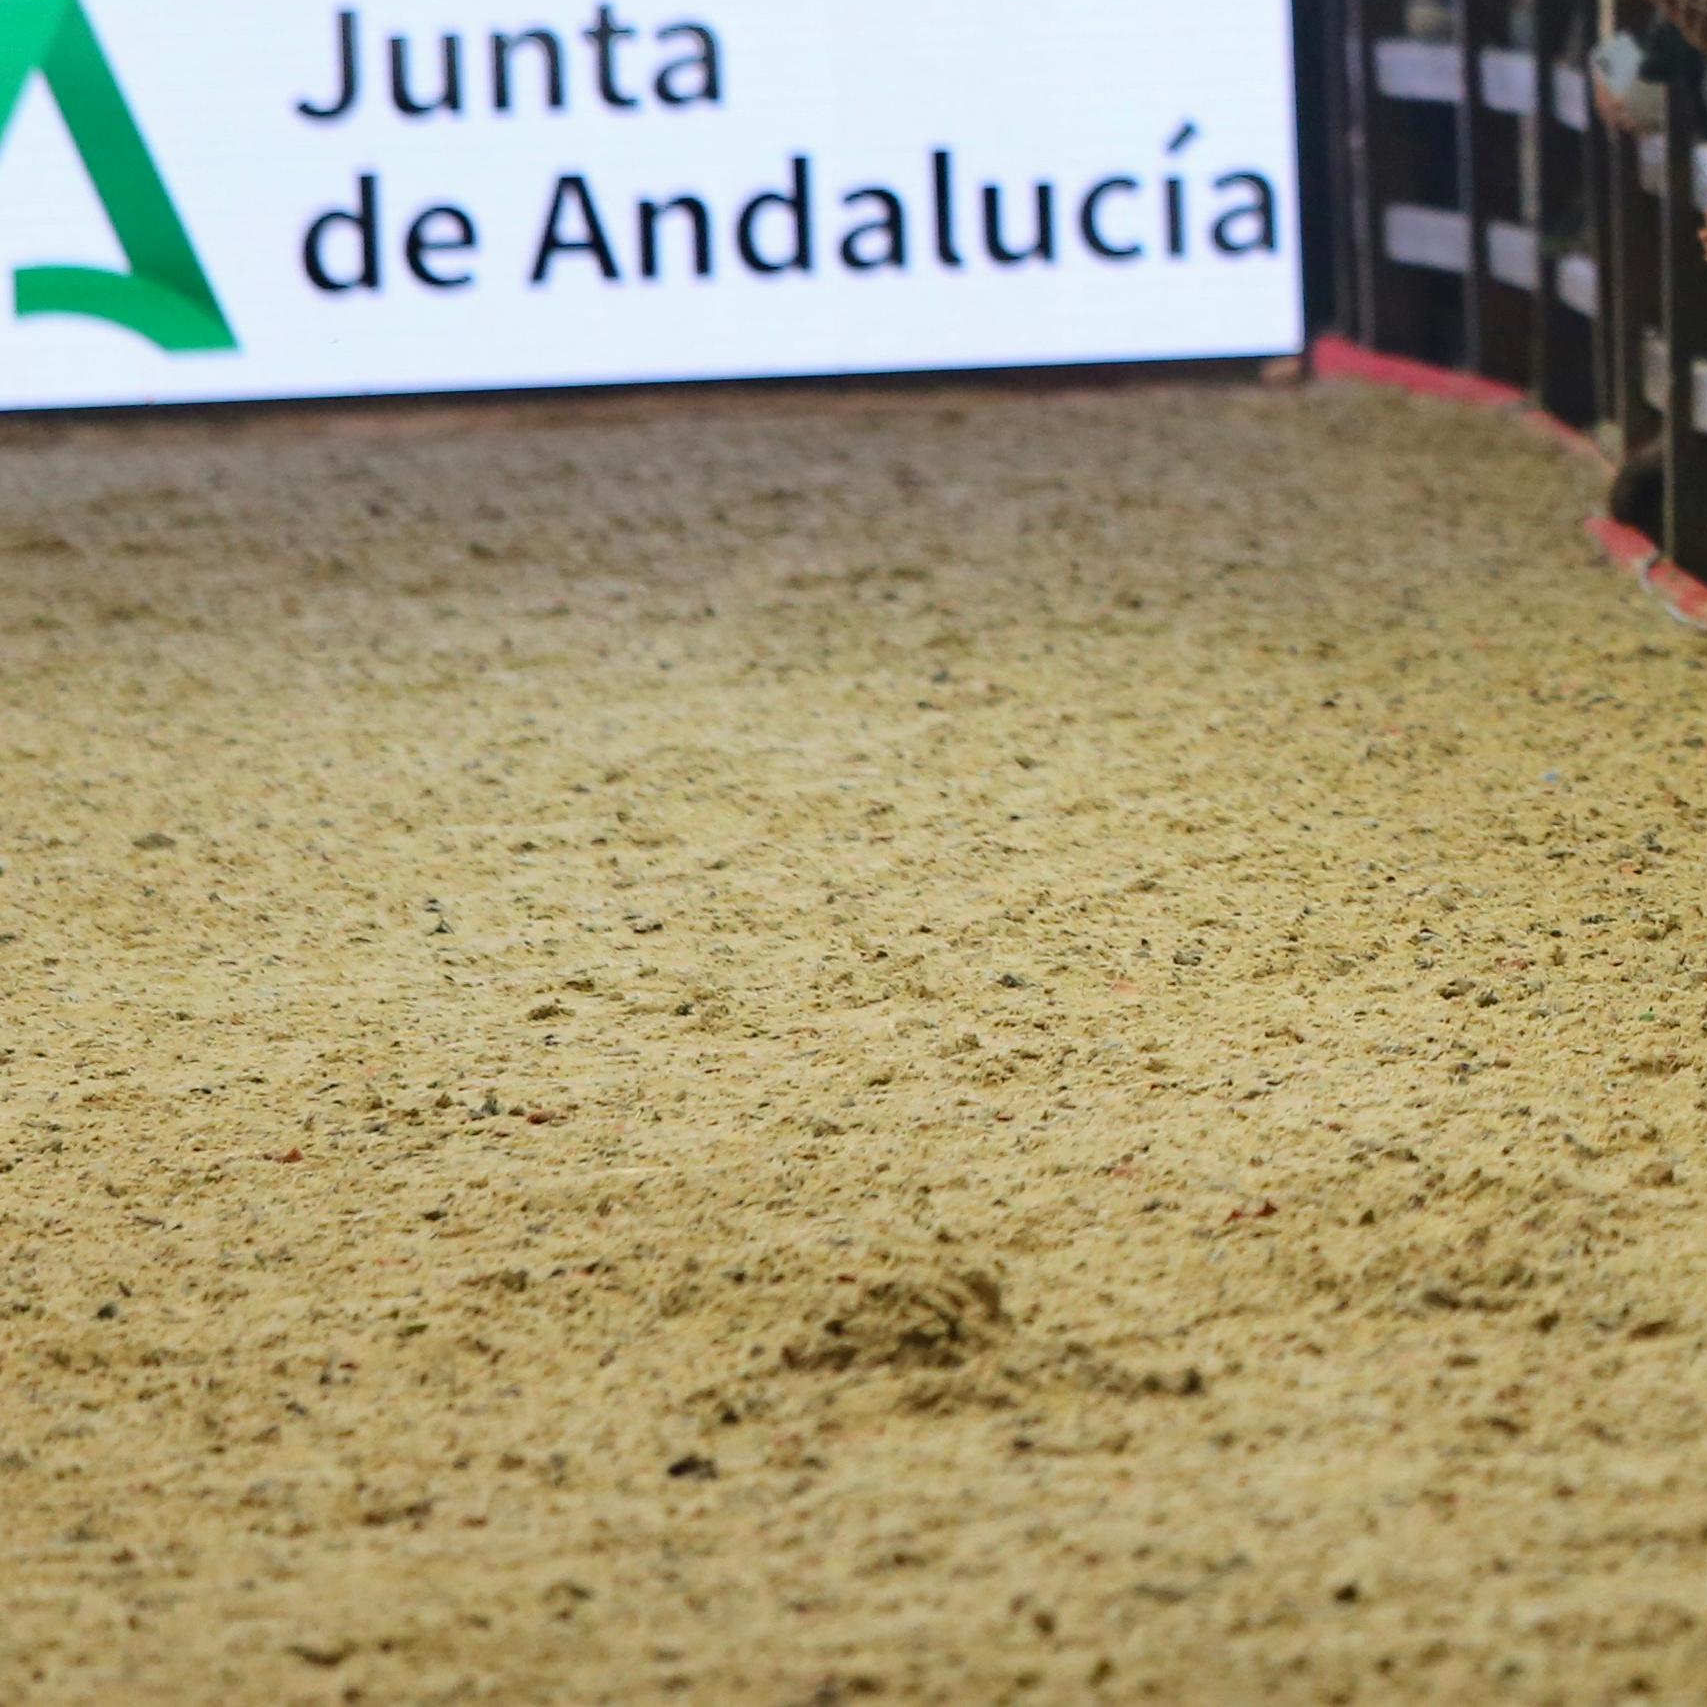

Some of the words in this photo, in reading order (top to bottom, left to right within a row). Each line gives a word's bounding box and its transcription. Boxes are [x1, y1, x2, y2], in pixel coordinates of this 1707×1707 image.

[297, 5, 725, 122] Junta
[301, 173, 478, 294] de
[529, 122, 1279, 287] Andalucía
